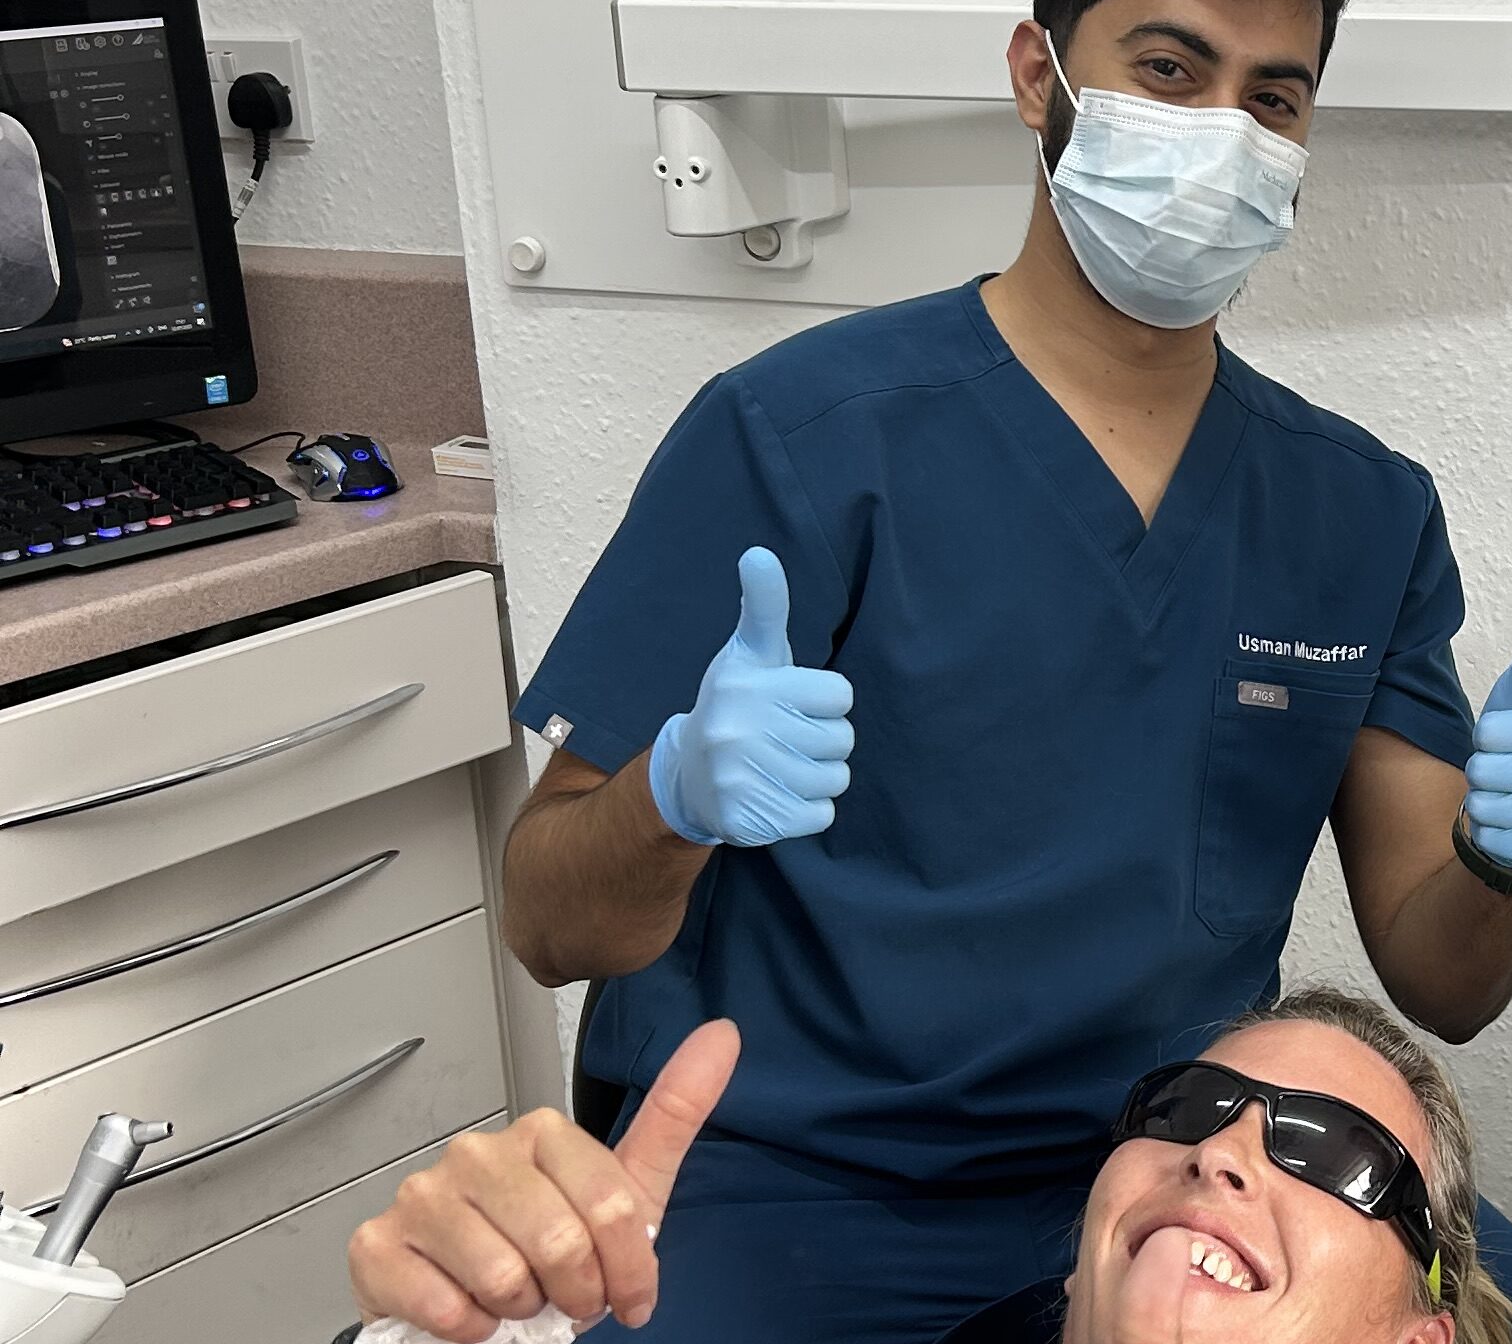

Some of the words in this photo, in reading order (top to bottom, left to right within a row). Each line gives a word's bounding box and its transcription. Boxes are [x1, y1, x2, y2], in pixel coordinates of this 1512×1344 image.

[1239, 633, 1292, 656] Usman
[1294, 640, 1368, 662] Muzaffar
[1252, 689, 1276, 702] FIGS
